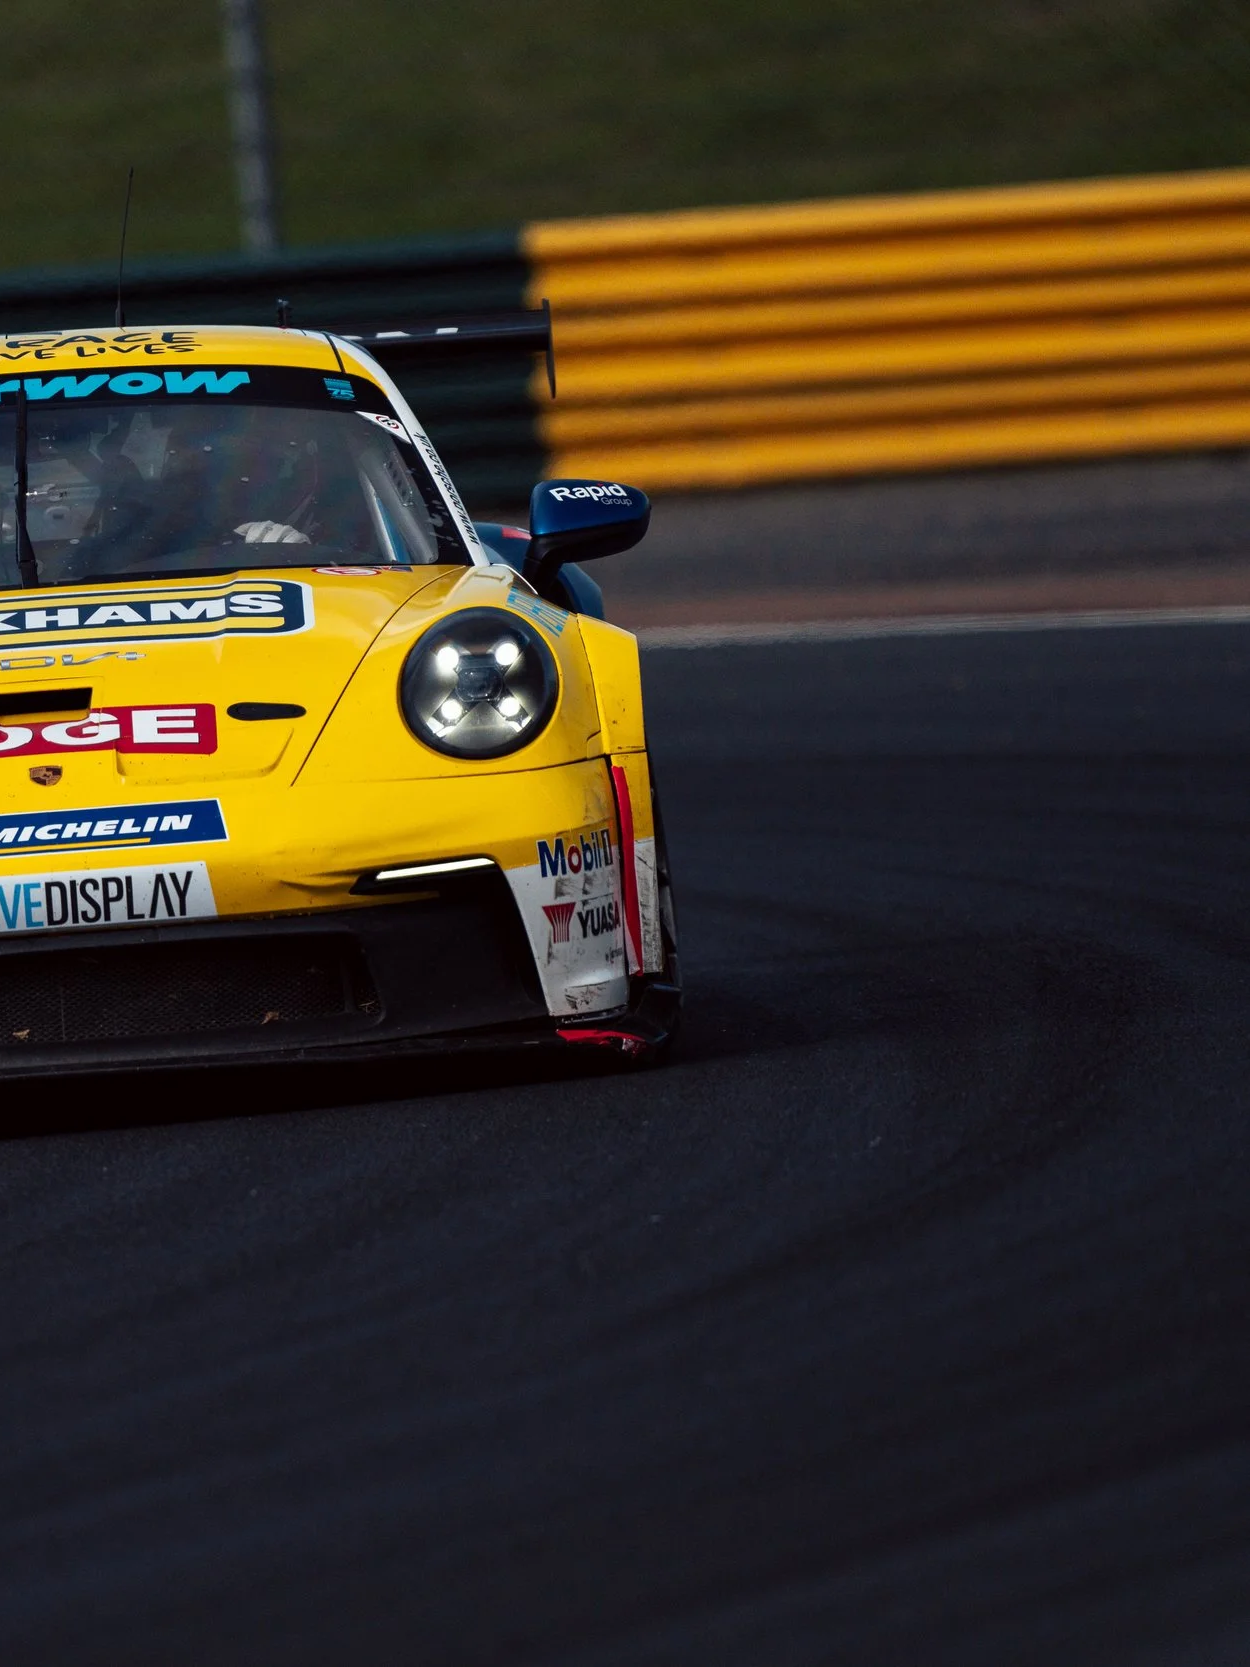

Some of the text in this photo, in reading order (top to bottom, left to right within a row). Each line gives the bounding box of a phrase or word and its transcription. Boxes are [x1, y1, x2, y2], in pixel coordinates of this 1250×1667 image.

[6, 331, 199, 350] RACE
[549, 482, 628, 501] Rapid
[600, 496, 633, 507] Group
[536, 831, 602, 878] Mobil
[576, 901, 620, 939] YUASA
